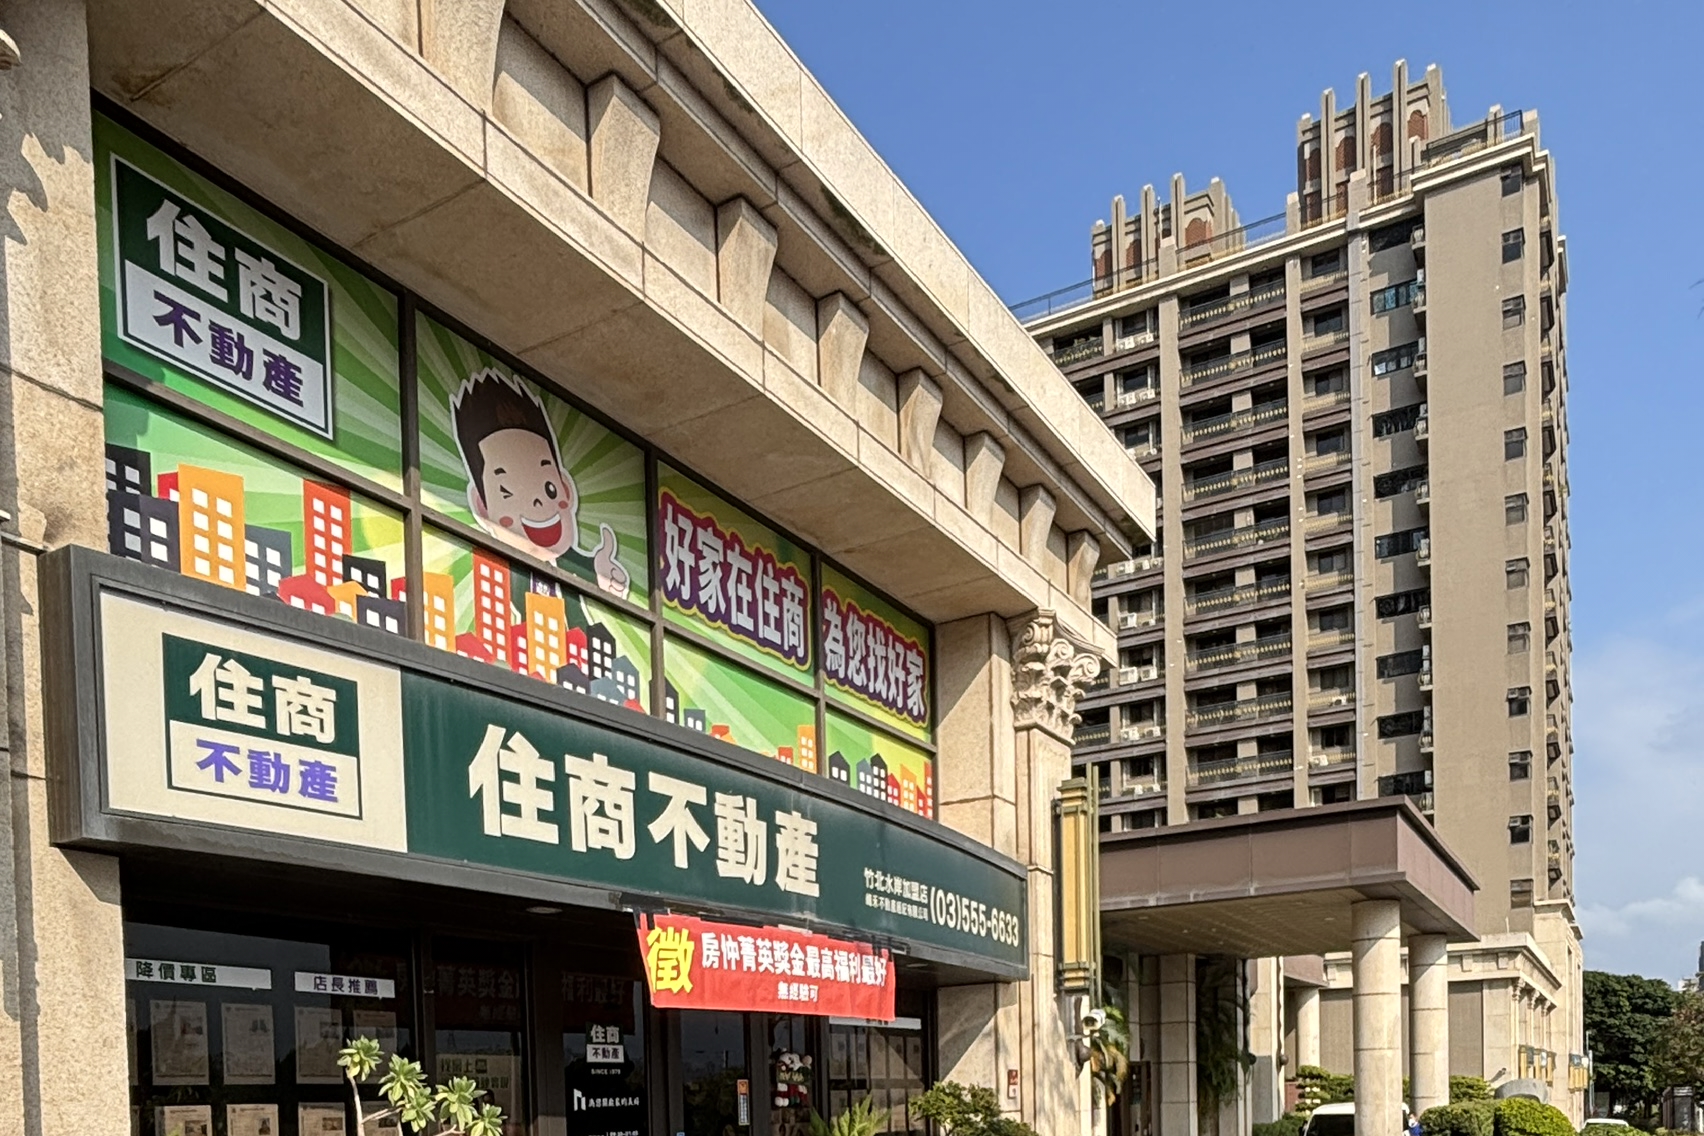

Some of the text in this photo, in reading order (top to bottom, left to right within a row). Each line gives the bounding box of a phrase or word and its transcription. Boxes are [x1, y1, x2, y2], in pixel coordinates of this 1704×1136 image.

[146, 199, 302, 342] 住商
[153, 291, 304, 408] 不動產
[663, 502, 809, 665] 好家在住商
[823, 598, 925, 717] 為您找好家
[188, 652, 338, 744] 住商
[195, 739, 338, 804] 不動產
[468, 724, 820, 898] 住商不動產
[864, 867, 928, 904] 竹北水岸加盟店
[930, 886, 1019, 947] (03)555-6633
[136, 961, 217, 983] 降價專區
[313, 976, 378, 996] 店長推薦
[437, 965, 520, 999] 菁英獎金
[646, 926, 887, 994] 徵 房仲菁英獎金最高福利最好
[777, 980, 819, 1003] 無經驗可
[591, 1024, 619, 1044] 住商
[592, 1047, 619, 1059] 不動產
